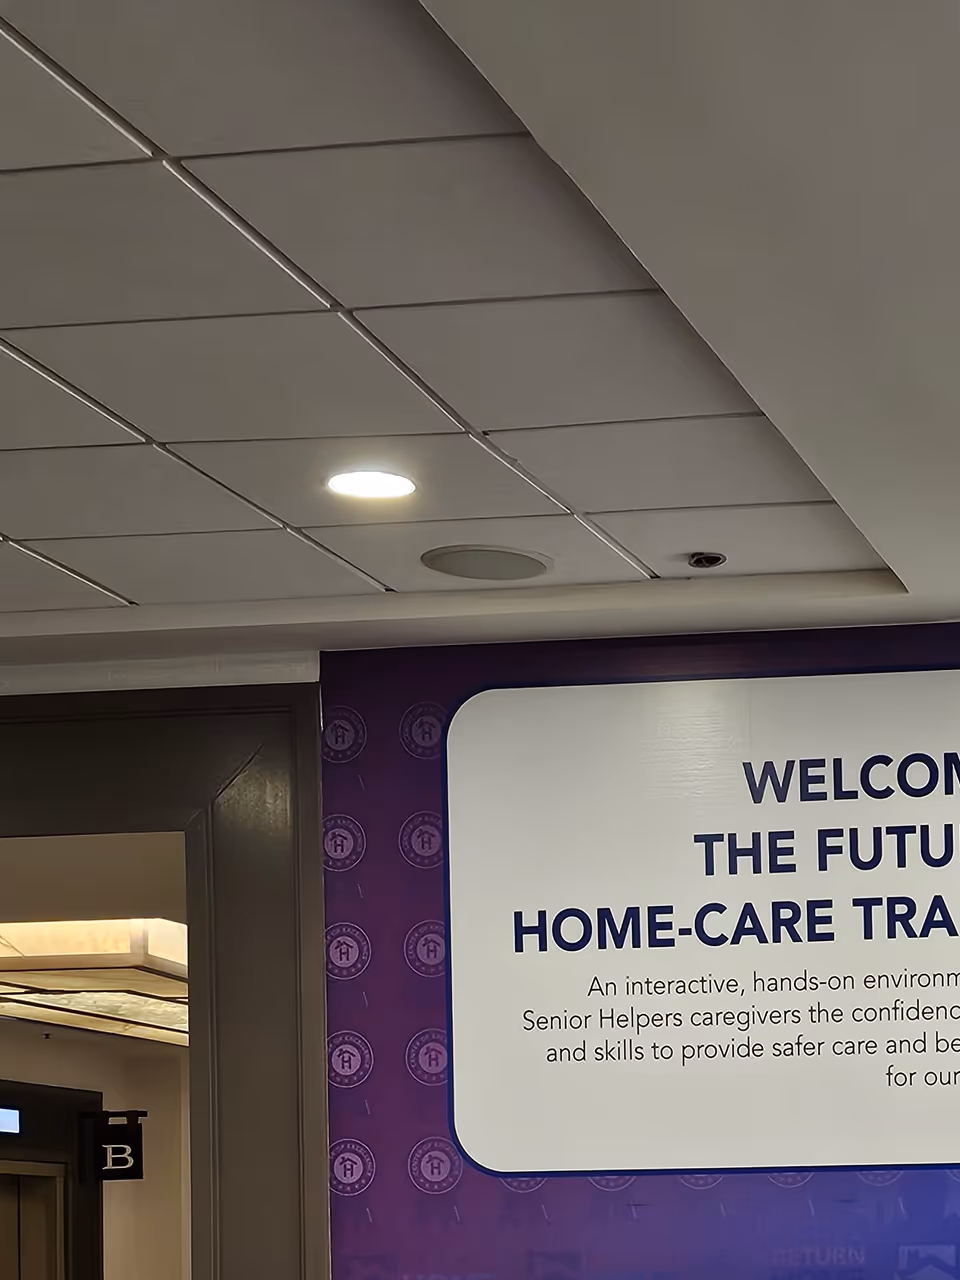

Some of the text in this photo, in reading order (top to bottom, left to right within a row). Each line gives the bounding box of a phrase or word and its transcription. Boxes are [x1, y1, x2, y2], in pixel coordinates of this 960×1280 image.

[693, 829, 797, 877] THE
[513, 898, 835, 954] HOME-CARE
[586, 975, 617, 998] An
[625, 973, 746, 997] interactive,
[753, 968, 855, 993] hands-on
[522, 1009, 593, 1032] Senior
[599, 1005, 683, 1036] Helpers
[689, 1004, 802, 1032] caregivers
[807, 1000, 845, 1025] the
[546, 1039, 587, 1063] and
[592, 1038, 645, 1062] skills
[648, 1041, 674, 1061] to
[681, 1035, 765, 1067] provide
[771, 1033, 826, 1058] safer
[831, 1039, 879, 1057] care
[885, 1030, 927, 1055] and
[885, 1063, 918, 1087] for
[102, 1144, 134, 1170] B
